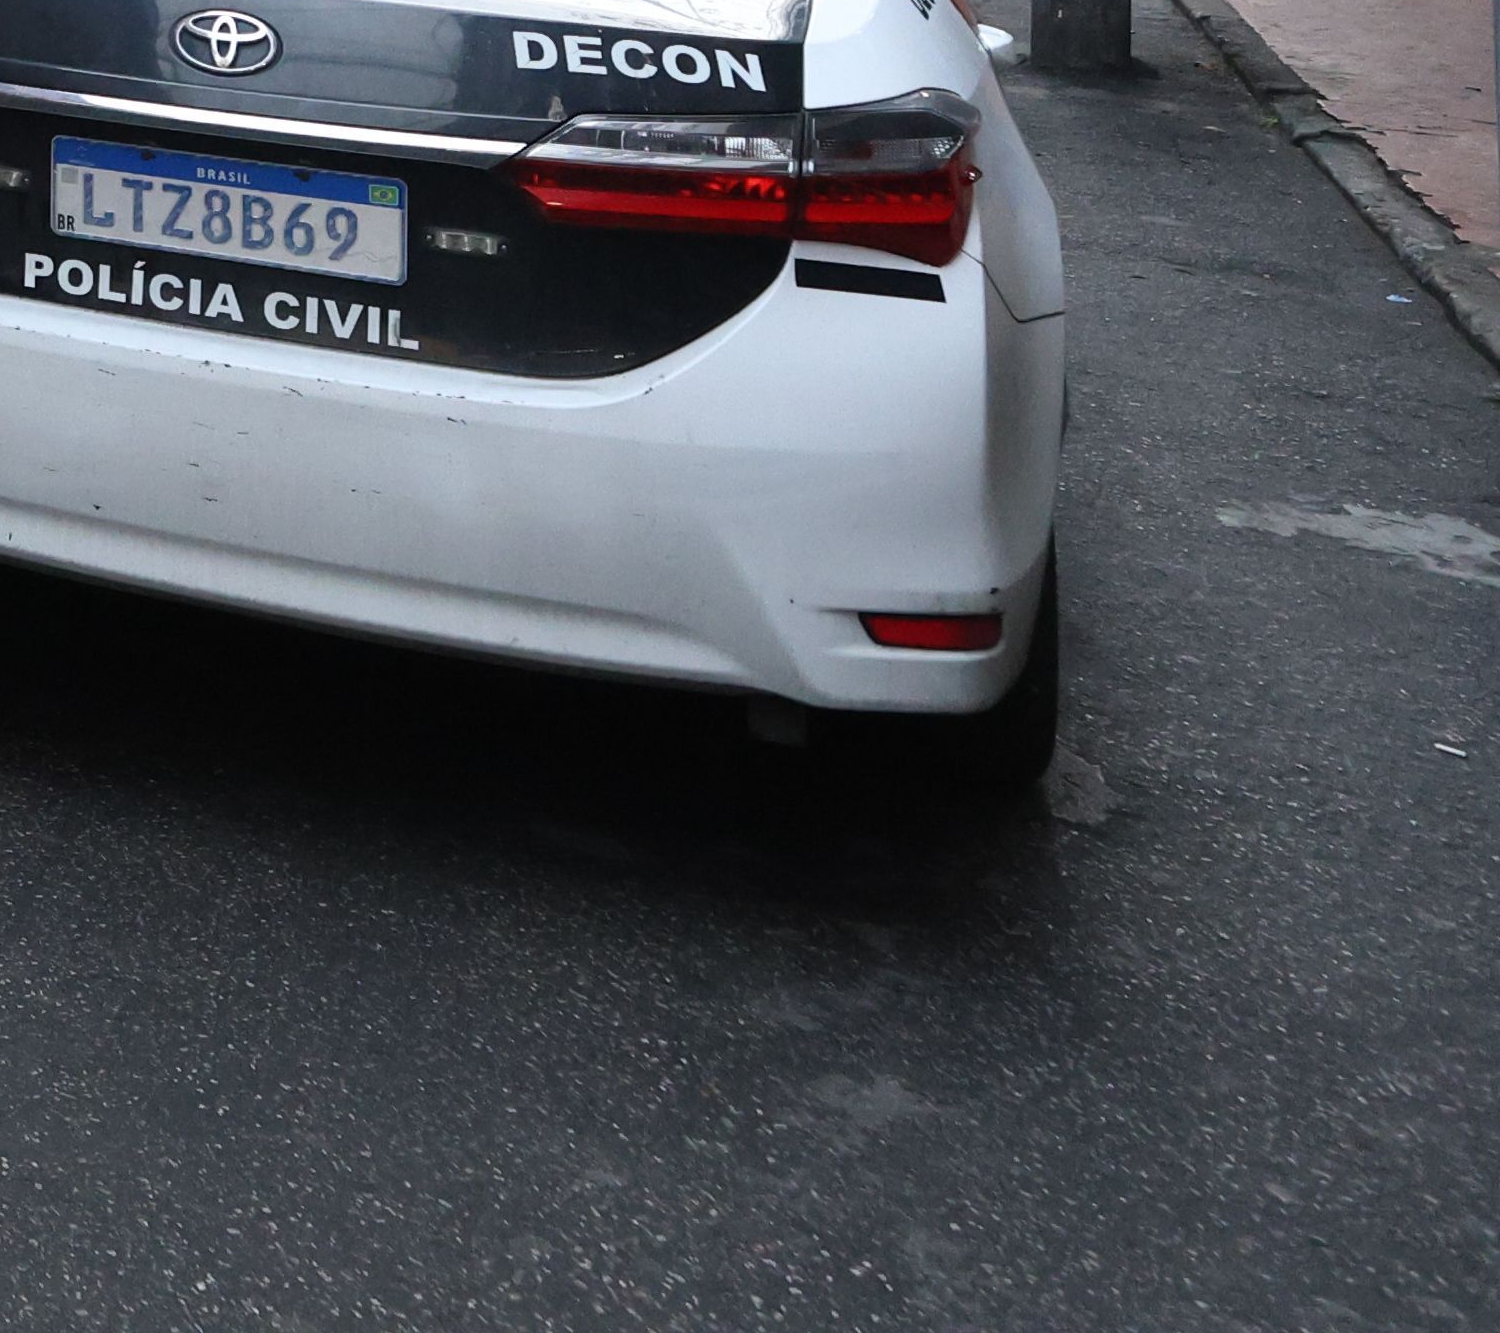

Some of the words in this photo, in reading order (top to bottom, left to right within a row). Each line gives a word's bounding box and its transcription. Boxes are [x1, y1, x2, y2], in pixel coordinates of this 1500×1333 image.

[512, 30, 767, 93] DECON
[196, 166, 251, 185] BRASIL
[56, 213, 76, 233] BR
[81, 172, 359, 261] LTZ8B69
[22, 251, 245, 323] POLÍCIA
[263, 291, 420, 351] CIVIL
